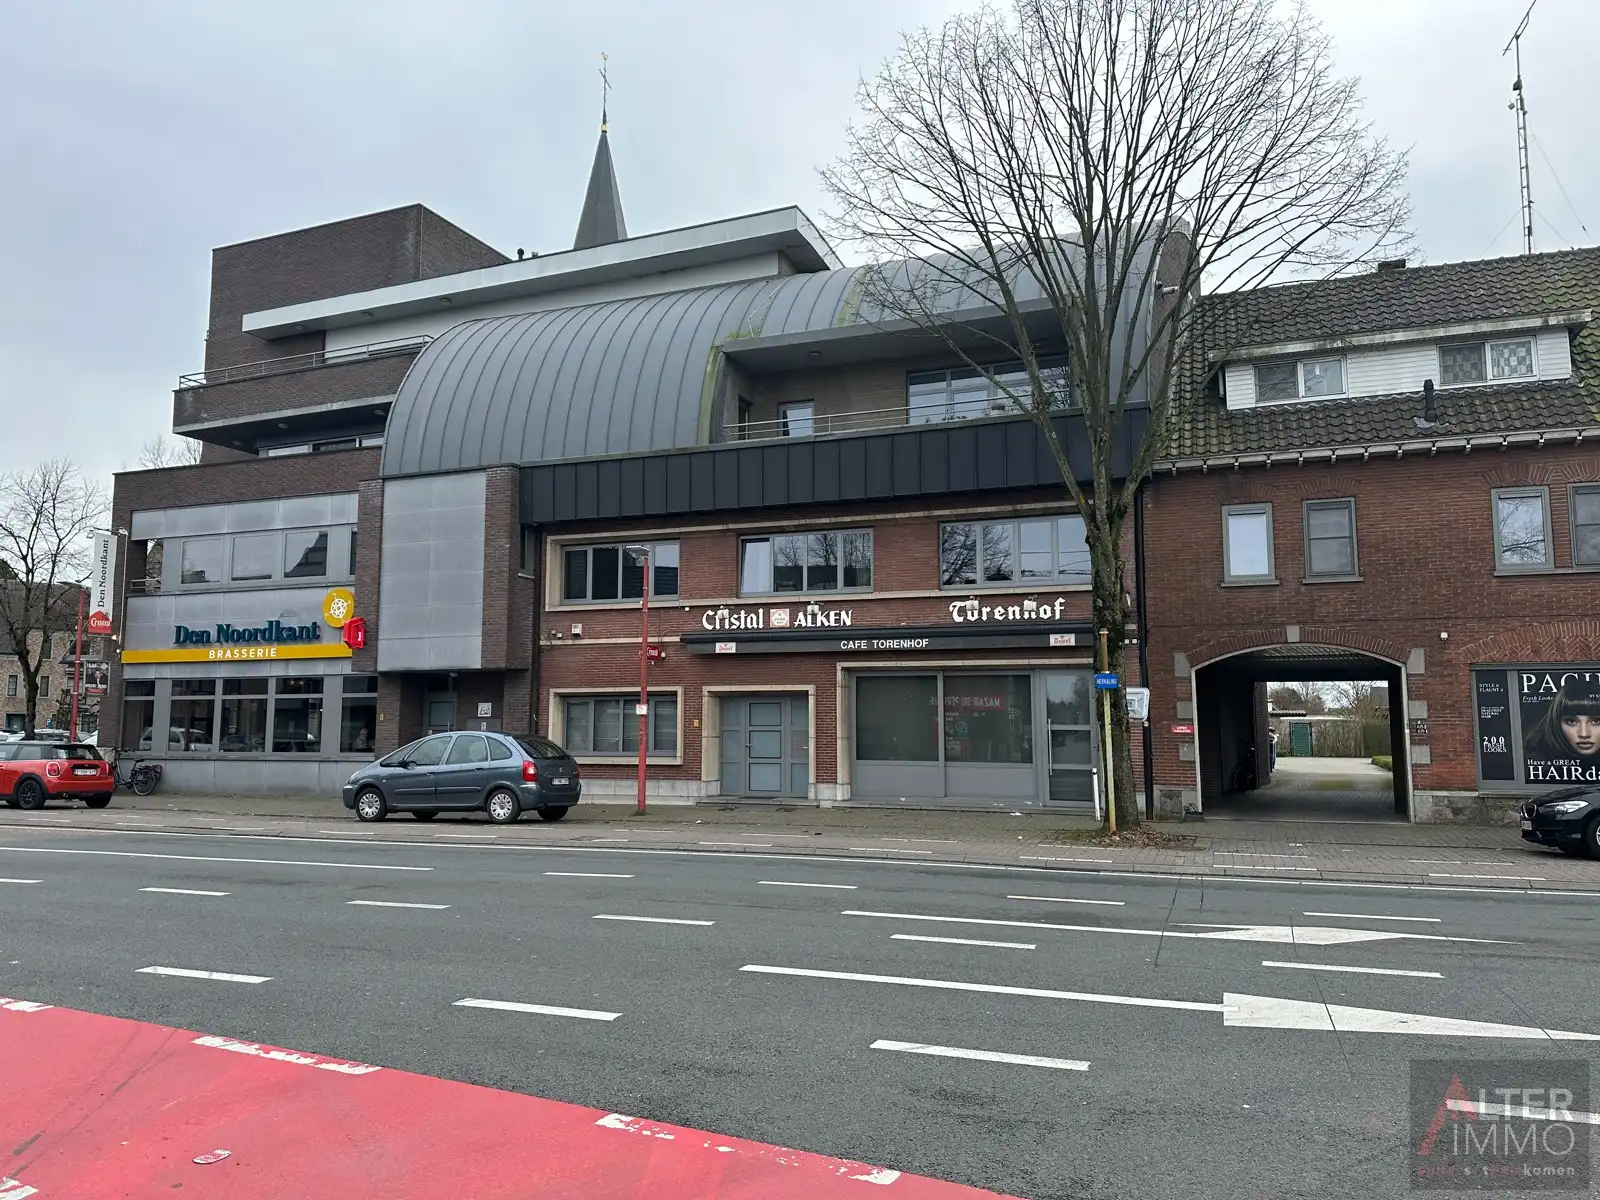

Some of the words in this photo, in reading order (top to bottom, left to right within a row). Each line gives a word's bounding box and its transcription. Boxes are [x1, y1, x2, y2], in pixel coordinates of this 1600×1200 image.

[98, 539, 110, 588] Noordkant
[97, 589, 106, 607] Den
[702, 608, 764, 630] Cristal
[793, 609, 853, 627] ALKEN
[173, 625, 212, 644] Den
[215, 620, 321, 644] Noordkant
[840, 640, 867, 649] CAFE
[872, 639, 929, 649] TORENHOF
[208, 648, 277, 660] BRASSERIE
[1483, 736, 1505, 744] 200
[1528, 766, 1600, 781] HAIRd
